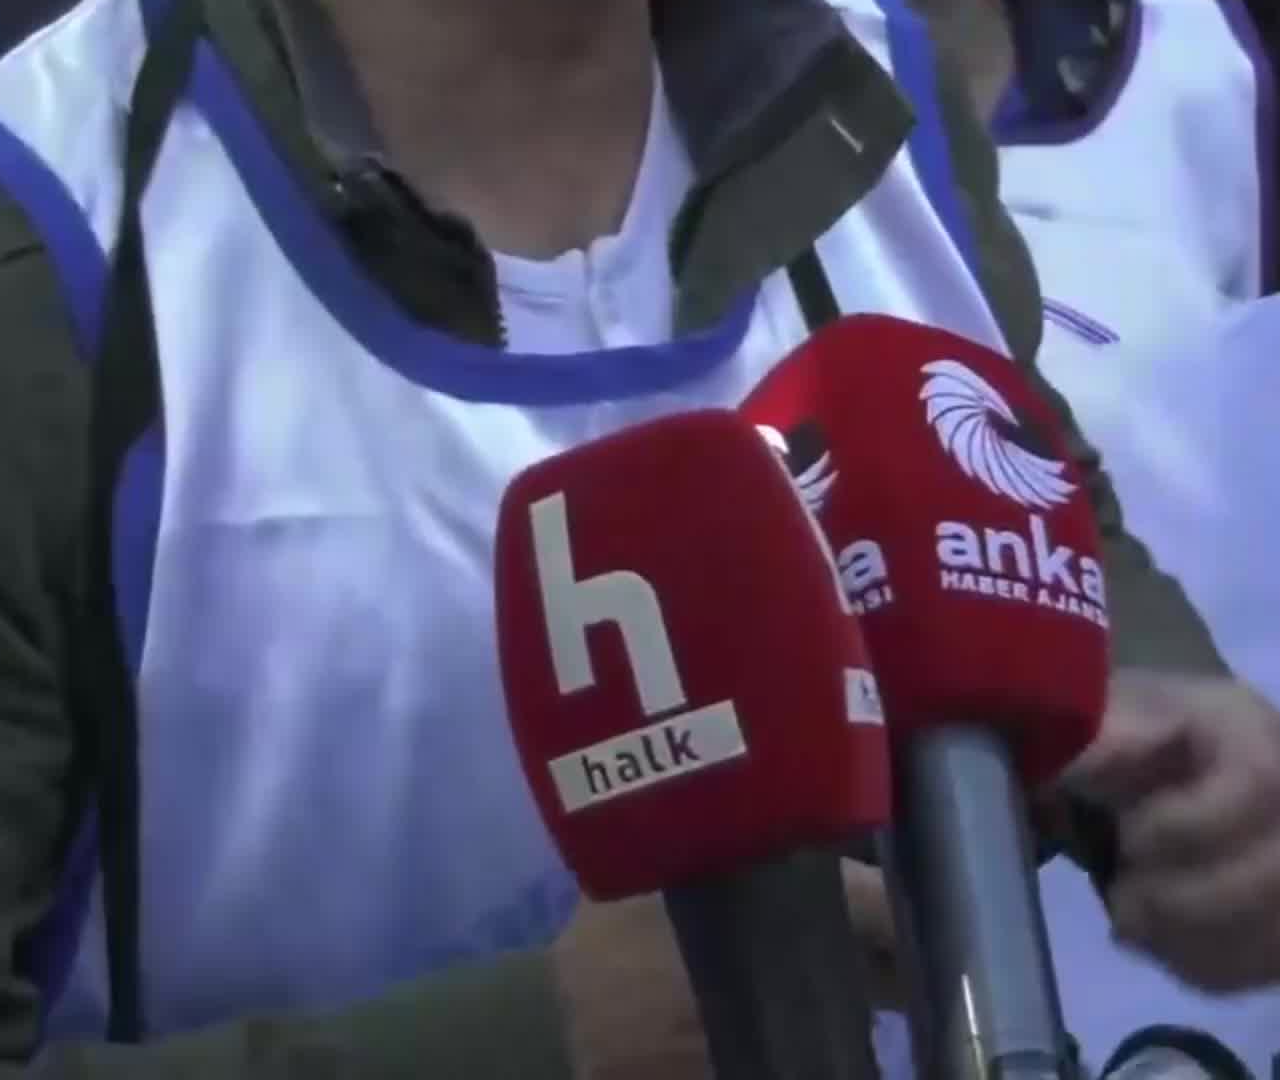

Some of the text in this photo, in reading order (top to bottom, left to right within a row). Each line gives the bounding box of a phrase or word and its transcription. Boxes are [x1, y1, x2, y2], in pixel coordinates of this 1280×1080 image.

[935, 513, 1107, 608] anka
[940, 570, 1031, 603] HABER
[581, 726, 700, 795] halk
